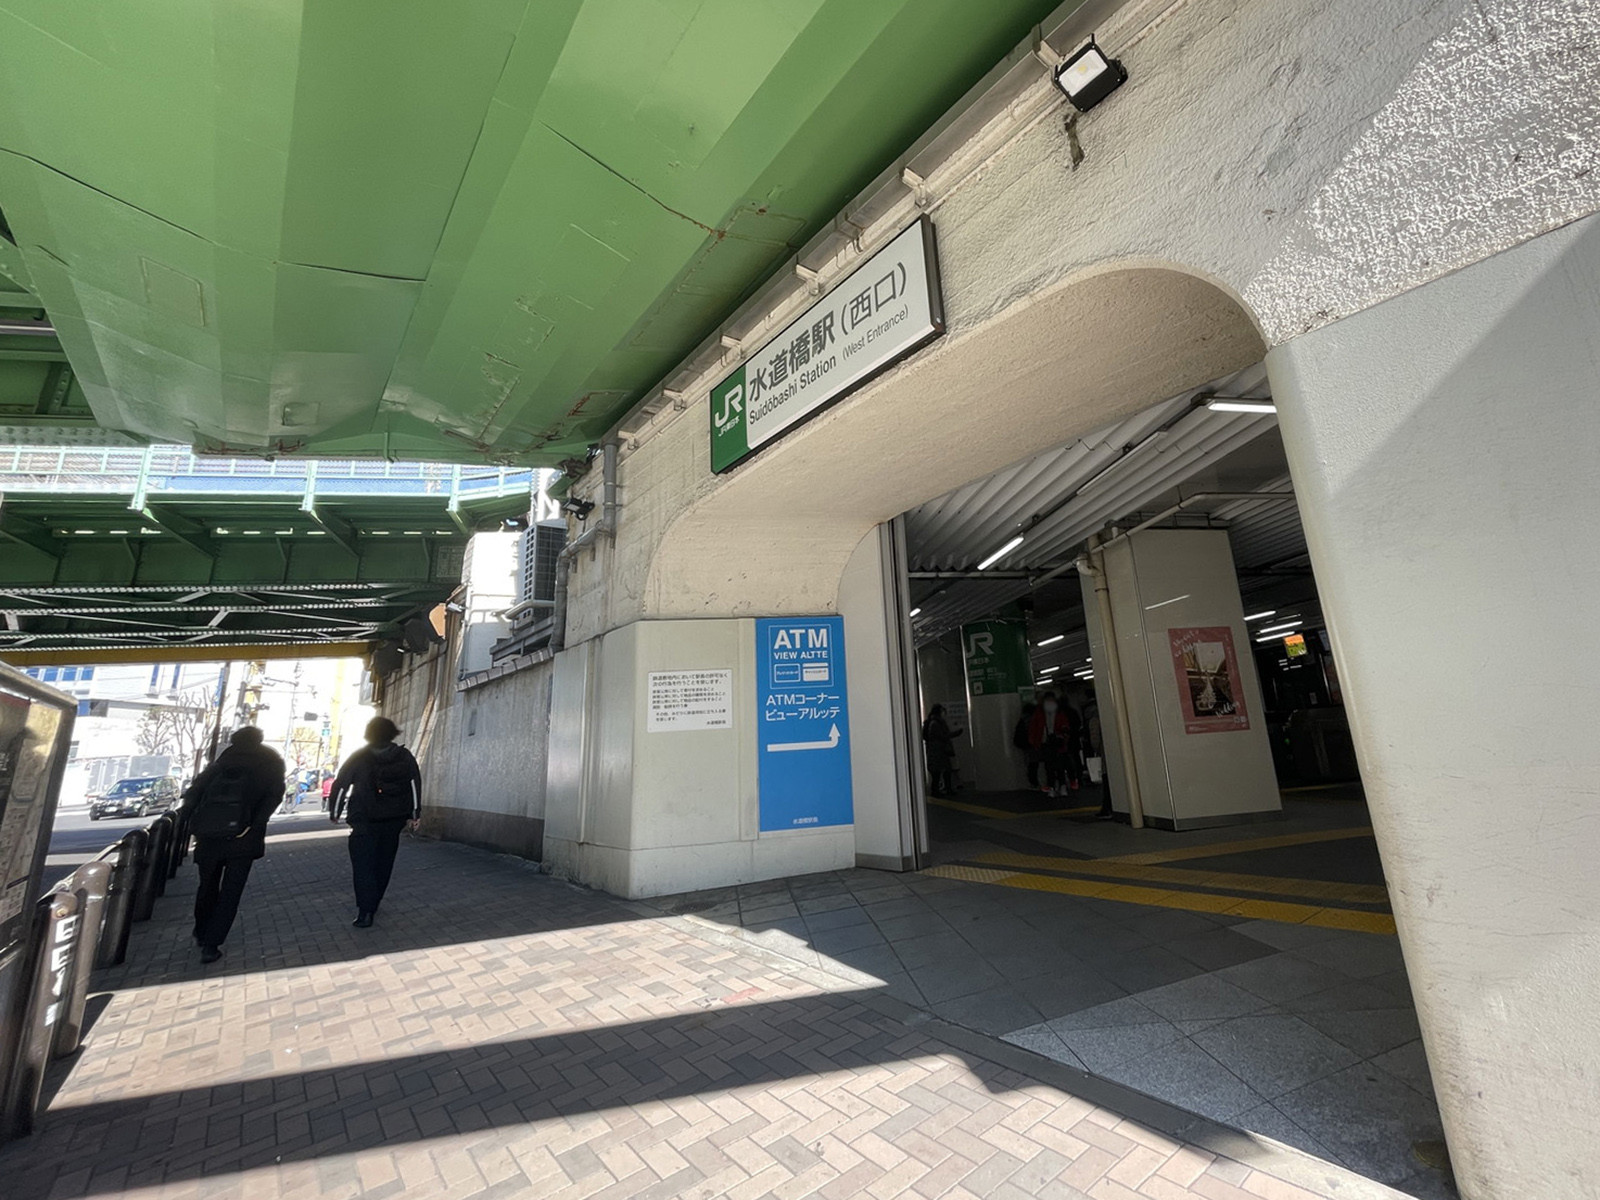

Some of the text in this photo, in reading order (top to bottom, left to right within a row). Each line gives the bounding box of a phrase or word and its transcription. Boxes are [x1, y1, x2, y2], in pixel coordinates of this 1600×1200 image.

[749, 303, 909, 425] Suidōbashi Station (West Entrance)
[714, 383, 744, 428] JR
[773, 628, 828, 650] ATM
[966, 631, 995, 659] JR
[773, 650, 829, 660] VIEW ALTTE
[765, 692, 840, 706] ATMコーナー
[765, 706, 841, 721] ビューアルッテ
